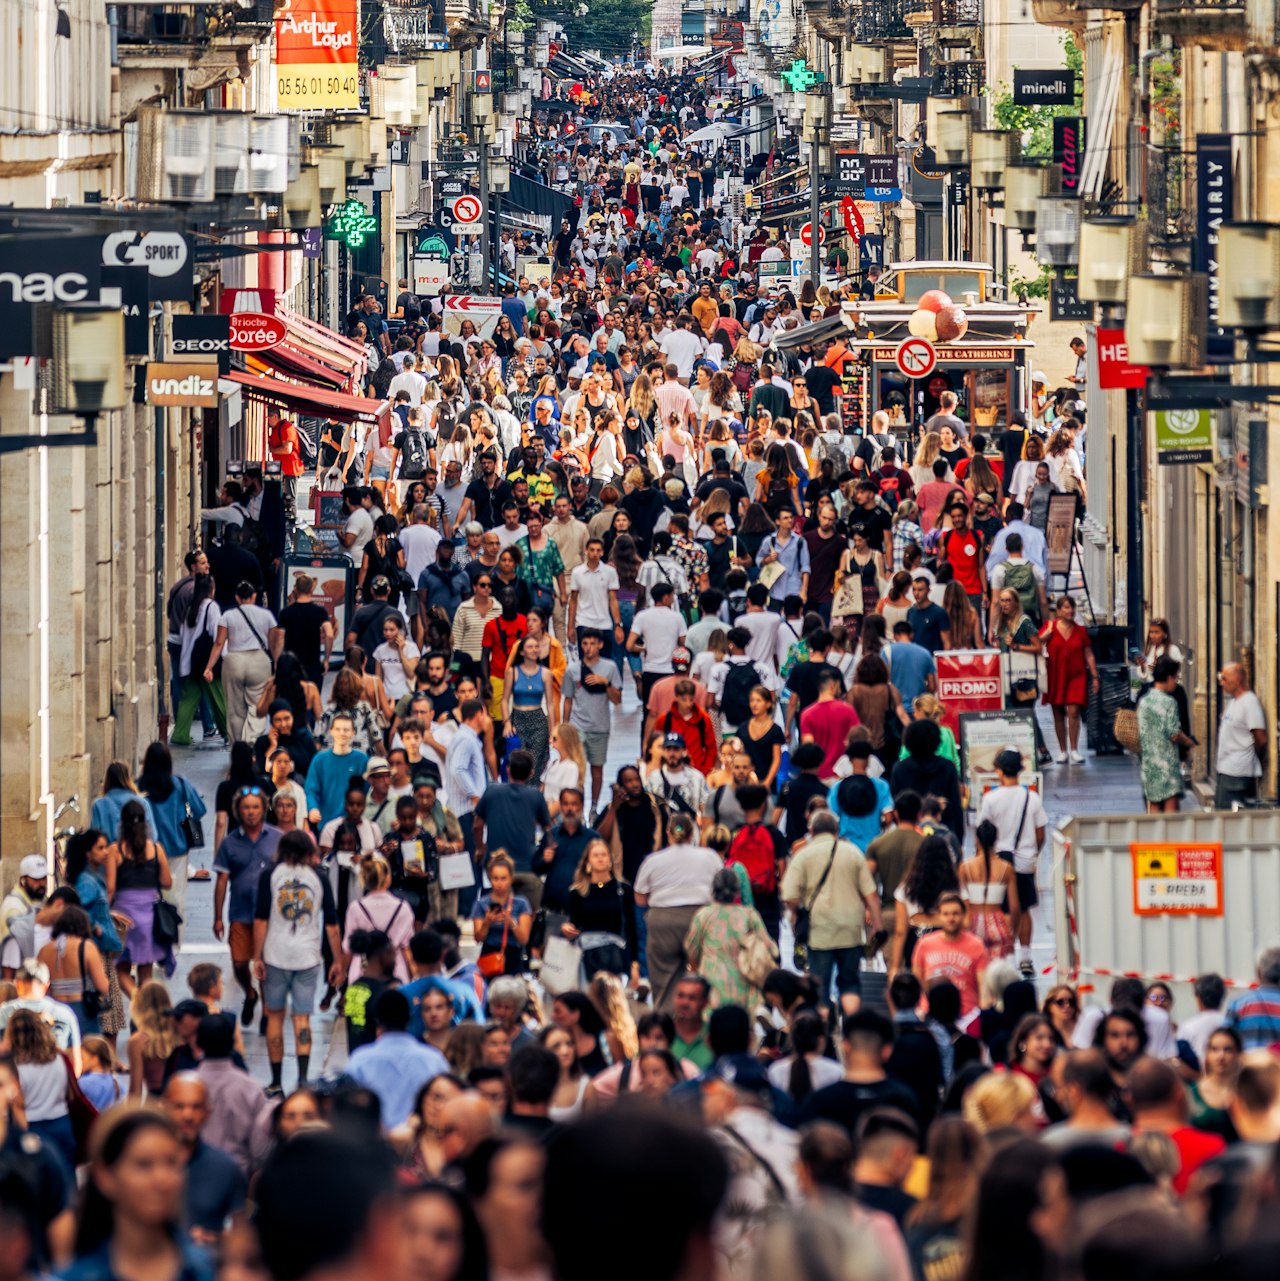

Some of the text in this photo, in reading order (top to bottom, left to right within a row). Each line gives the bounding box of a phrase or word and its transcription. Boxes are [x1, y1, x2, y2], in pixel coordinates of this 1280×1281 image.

[280, 11, 338, 34] Arthur
[312, 29, 352, 51] Loyd
[279, 77, 356, 95] 05 56 01 50 40
[1021, 80, 1067, 95] minelli
[334, 217, 377, 233] 17:22
[846, 205, 861, 240] TABAC
[145, 245, 180, 261] SPORT
[1209, 258, 1222, 321] IMMY
[232, 317, 268, 328] Brioche
[172, 338, 228, 352] GEOX
[955, 349, 1010, 359] CATHERINE
[151, 375, 215, 397] undiz
[942, 681, 998, 696] PROMO
